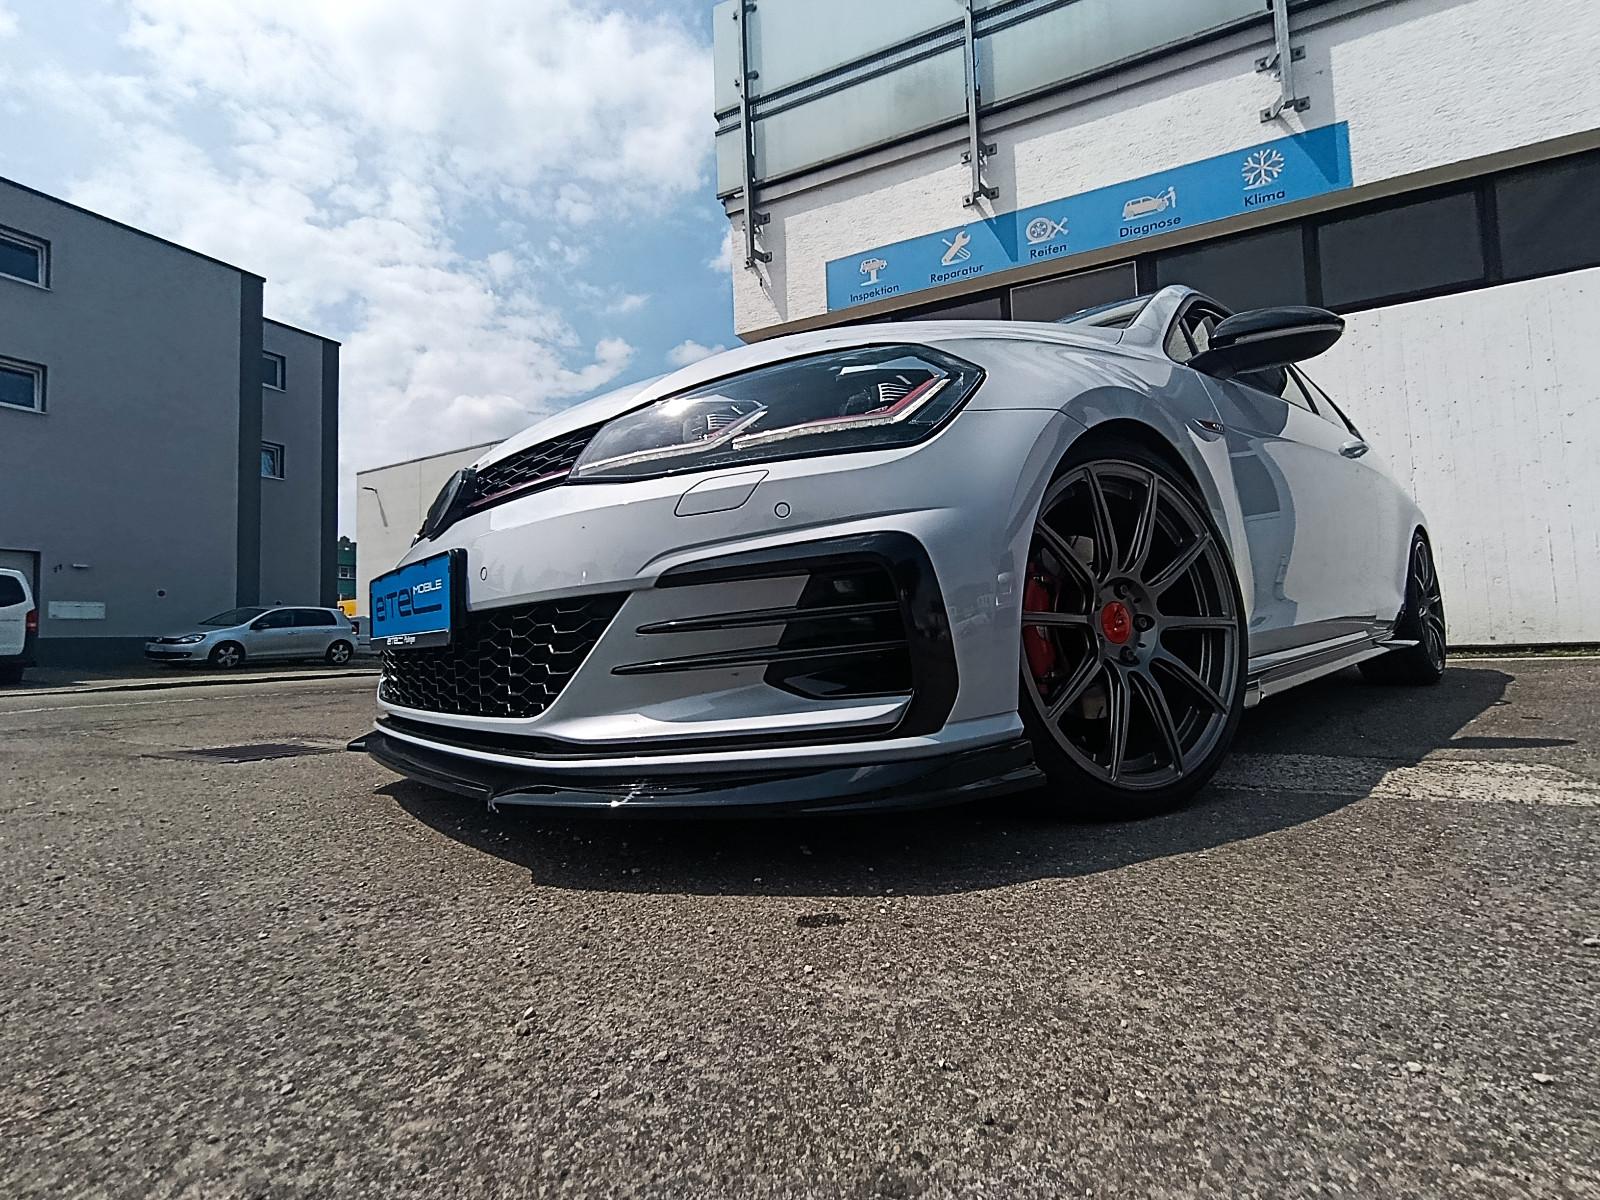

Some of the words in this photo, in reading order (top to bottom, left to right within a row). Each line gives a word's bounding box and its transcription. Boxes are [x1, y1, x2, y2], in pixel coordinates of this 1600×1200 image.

[1244, 190, 1286, 207] Klima
[1119, 216, 1182, 238] Diagnose
[1030, 243, 1068, 259] Reifen
[930, 264, 985, 283] Reparatur
[850, 284, 900, 303] Inspektion
